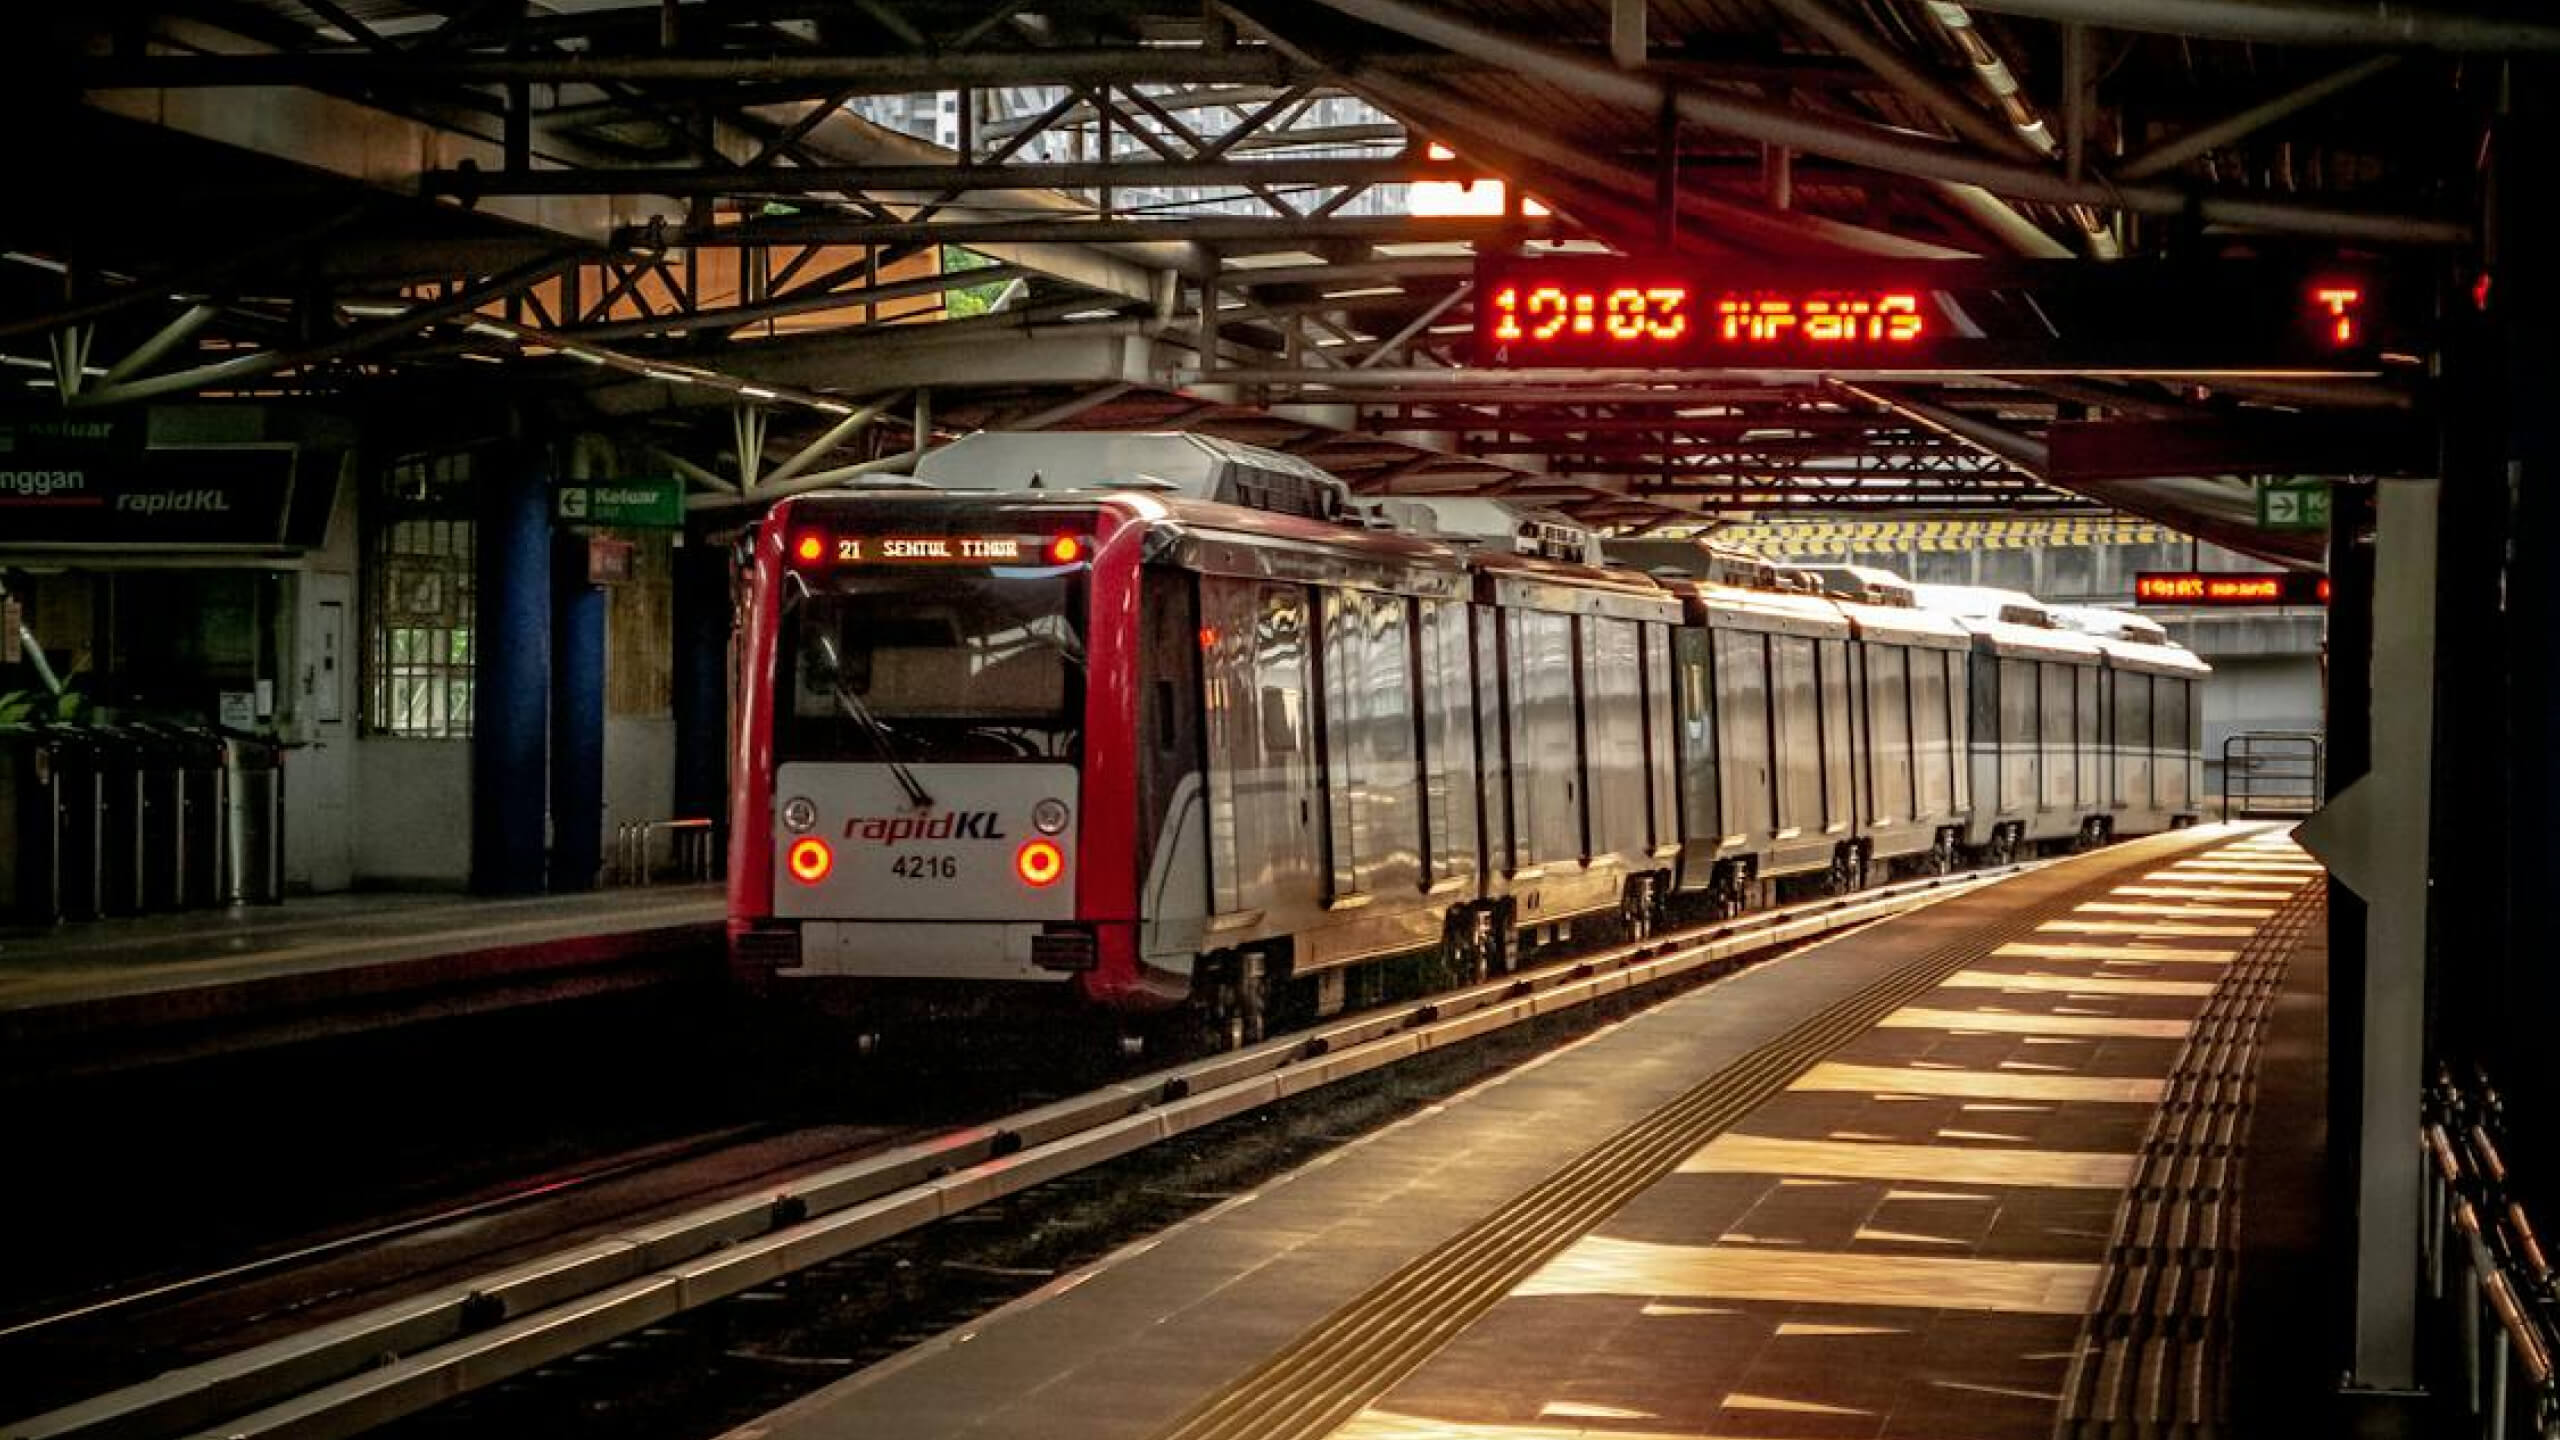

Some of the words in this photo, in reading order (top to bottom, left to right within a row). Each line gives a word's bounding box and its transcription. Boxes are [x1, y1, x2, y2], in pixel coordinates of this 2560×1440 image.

[1495, 287, 1686, 340] 19:03
[115, 488, 231, 516] rapidKL
[594, 487, 660, 505] Keluar
[838, 538, 860, 560] 21
[882, 538, 952, 558] SENTUL
[844, 811, 1006, 847] rapidKL
[891, 856, 957, 879] 4216
